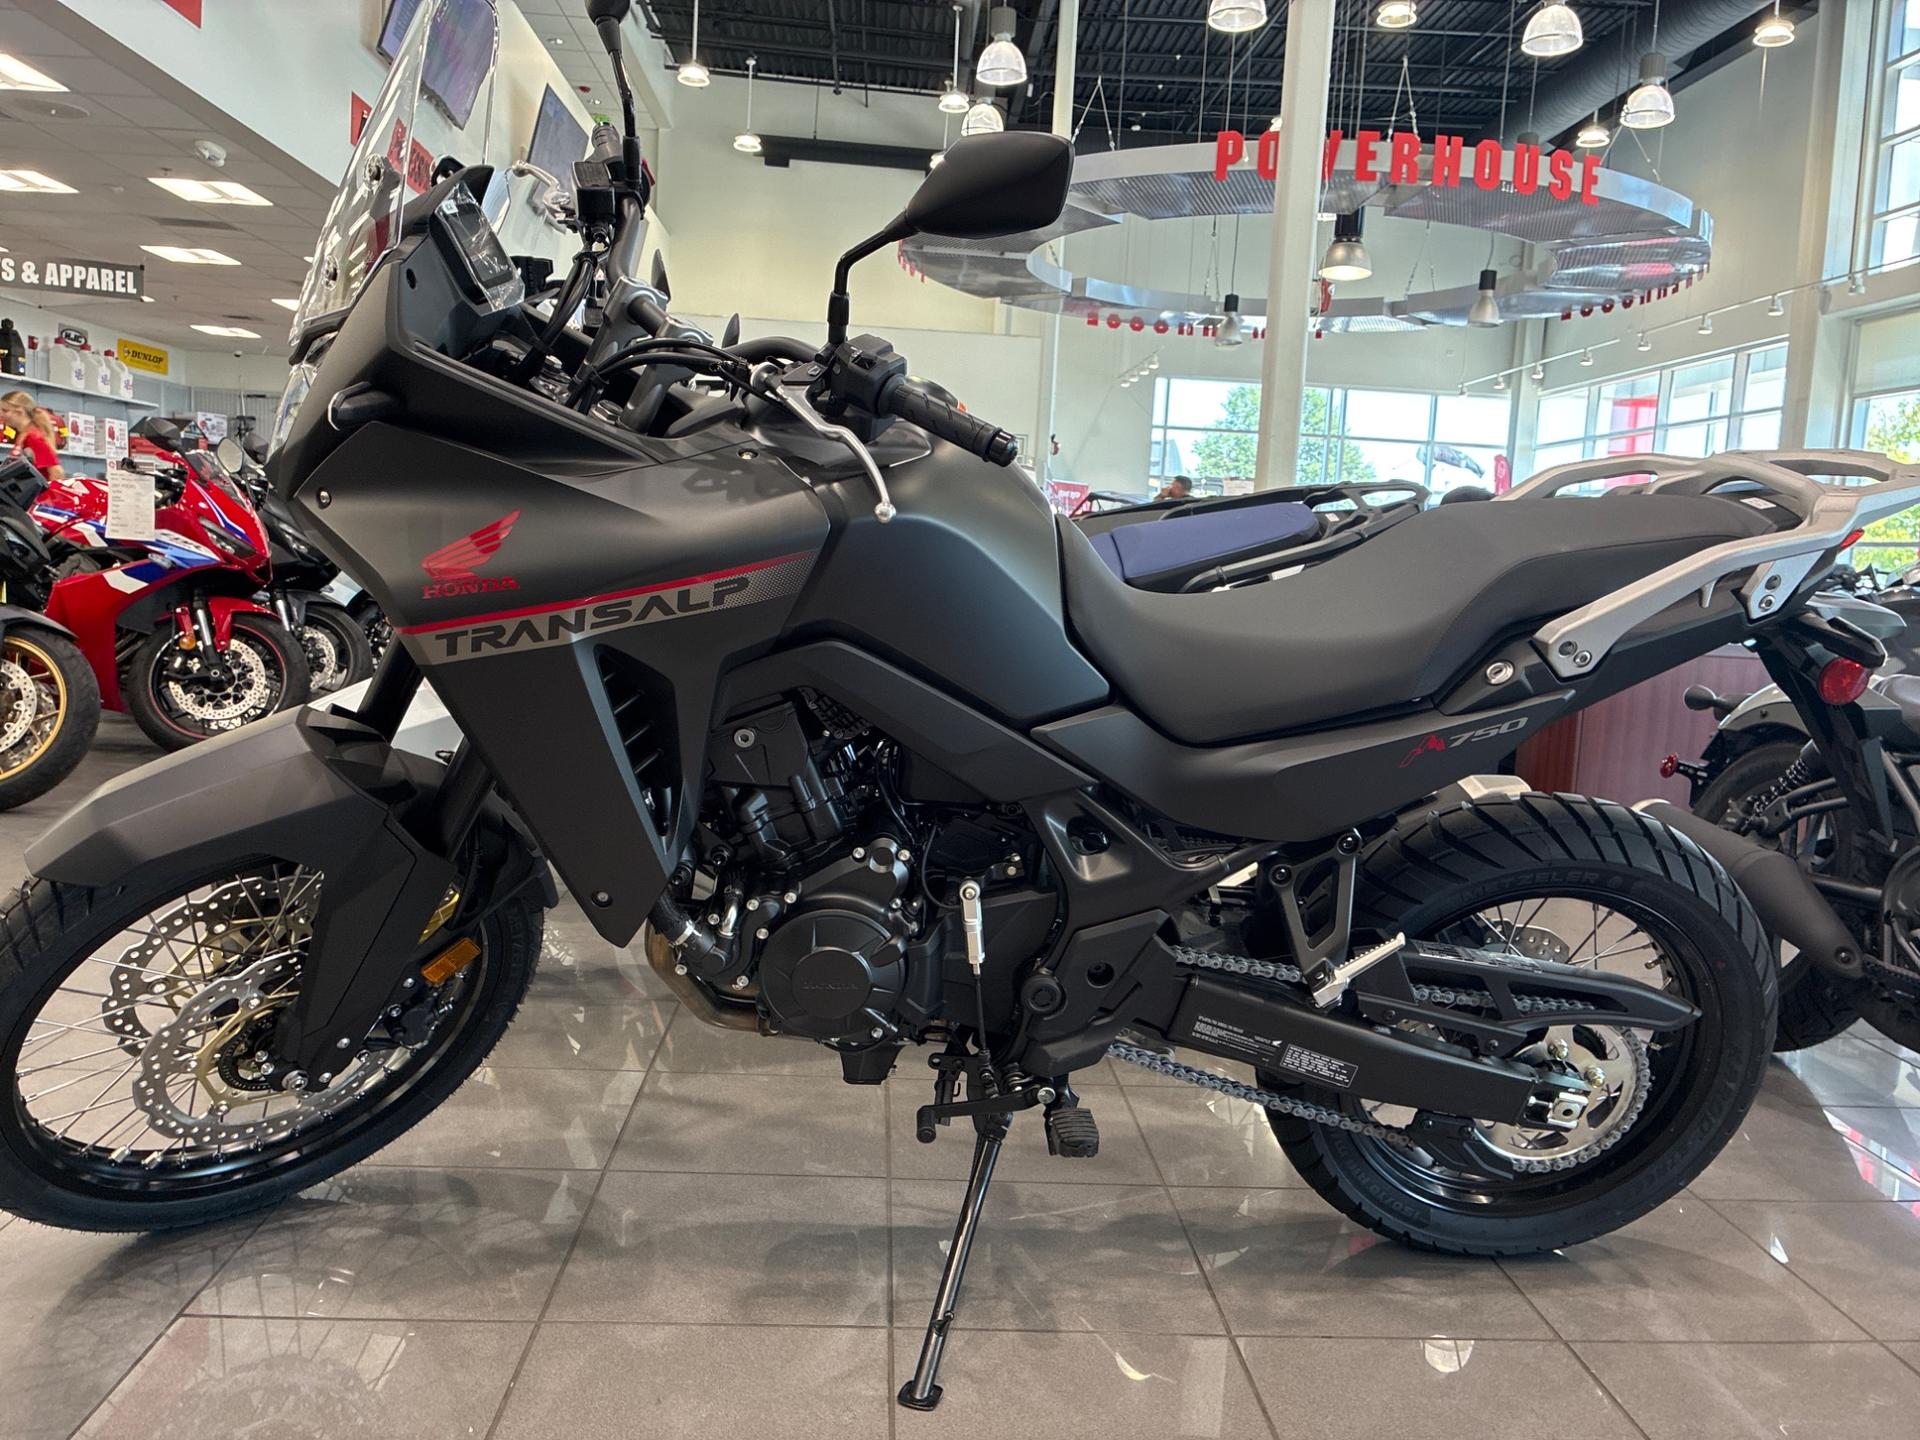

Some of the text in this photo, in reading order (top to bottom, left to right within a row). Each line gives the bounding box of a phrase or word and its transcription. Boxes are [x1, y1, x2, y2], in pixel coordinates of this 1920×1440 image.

[21, 261, 40, 285] &
[45, 262, 138, 295] APPAREL
[130, 350, 164, 365] DUNLOP
[422, 575, 521, 600] HONDA
[434, 577, 751, 657] TRANSALP
[1449, 716, 1529, 749] 750
